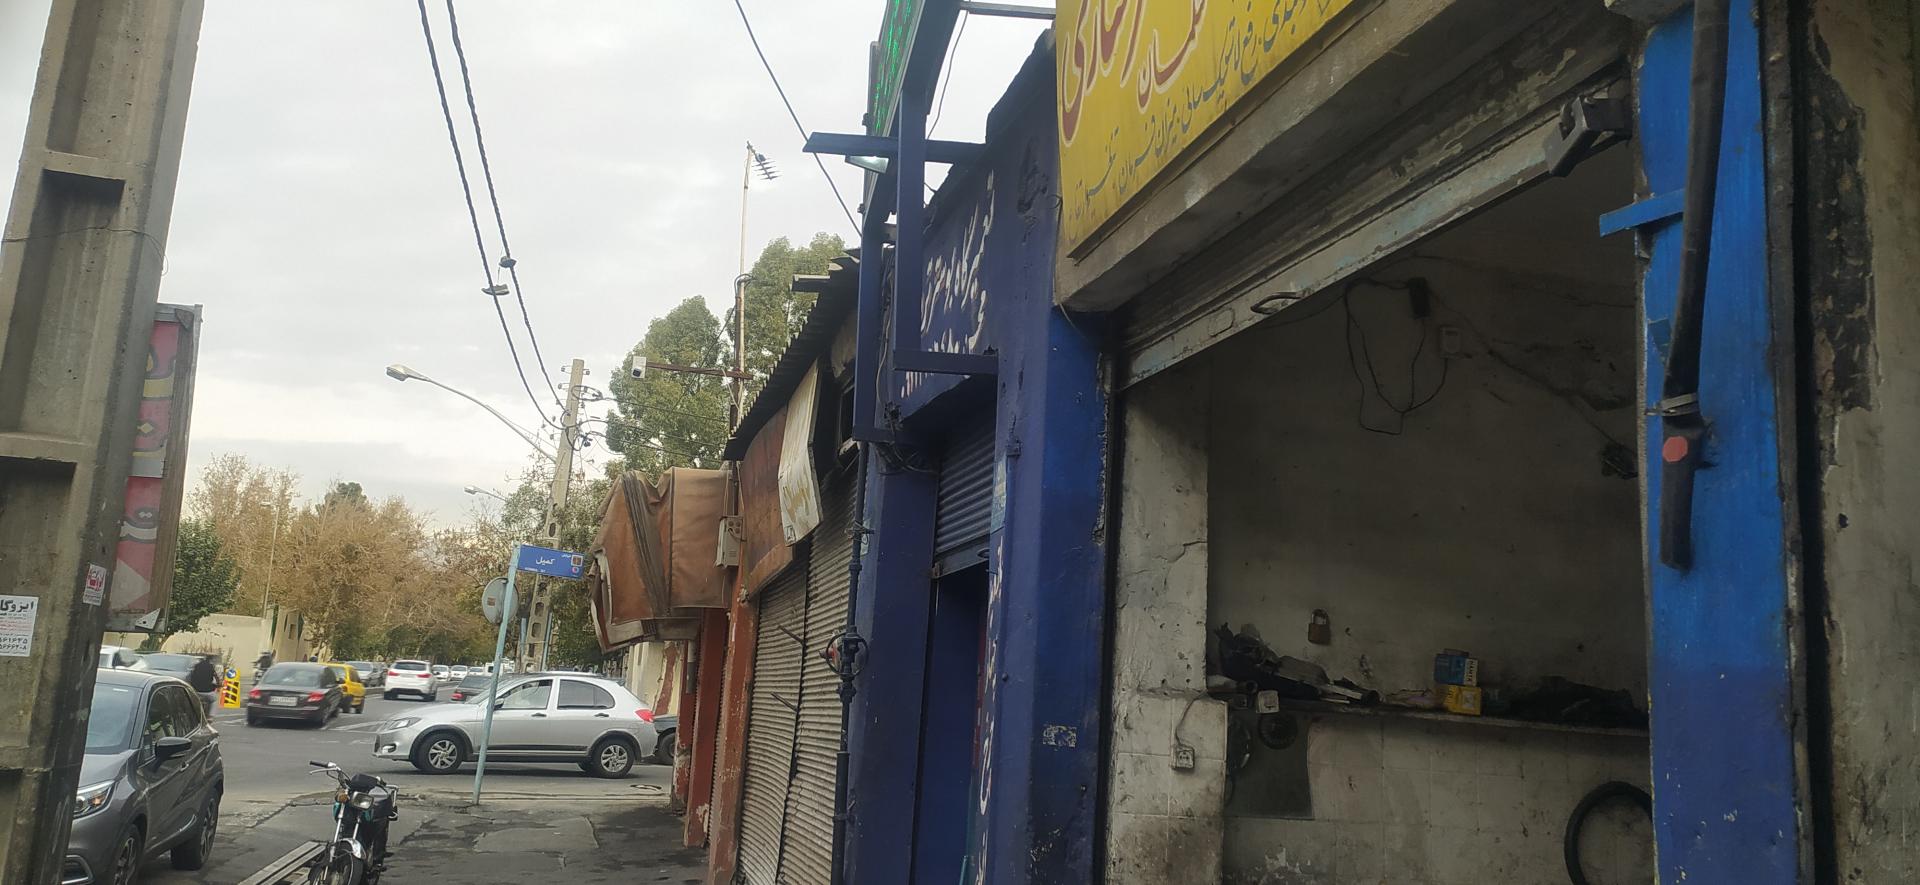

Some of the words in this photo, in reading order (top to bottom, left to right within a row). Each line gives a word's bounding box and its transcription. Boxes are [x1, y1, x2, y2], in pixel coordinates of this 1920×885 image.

[1119, 115, 1156, 194] فرمان
[1154, 98, 1177, 157] میزان
[955, 169, 995, 309] تعمیرگاه
[535, 556, 556, 566] کمیل
[0, 599, 34, 613] ایزوگا
